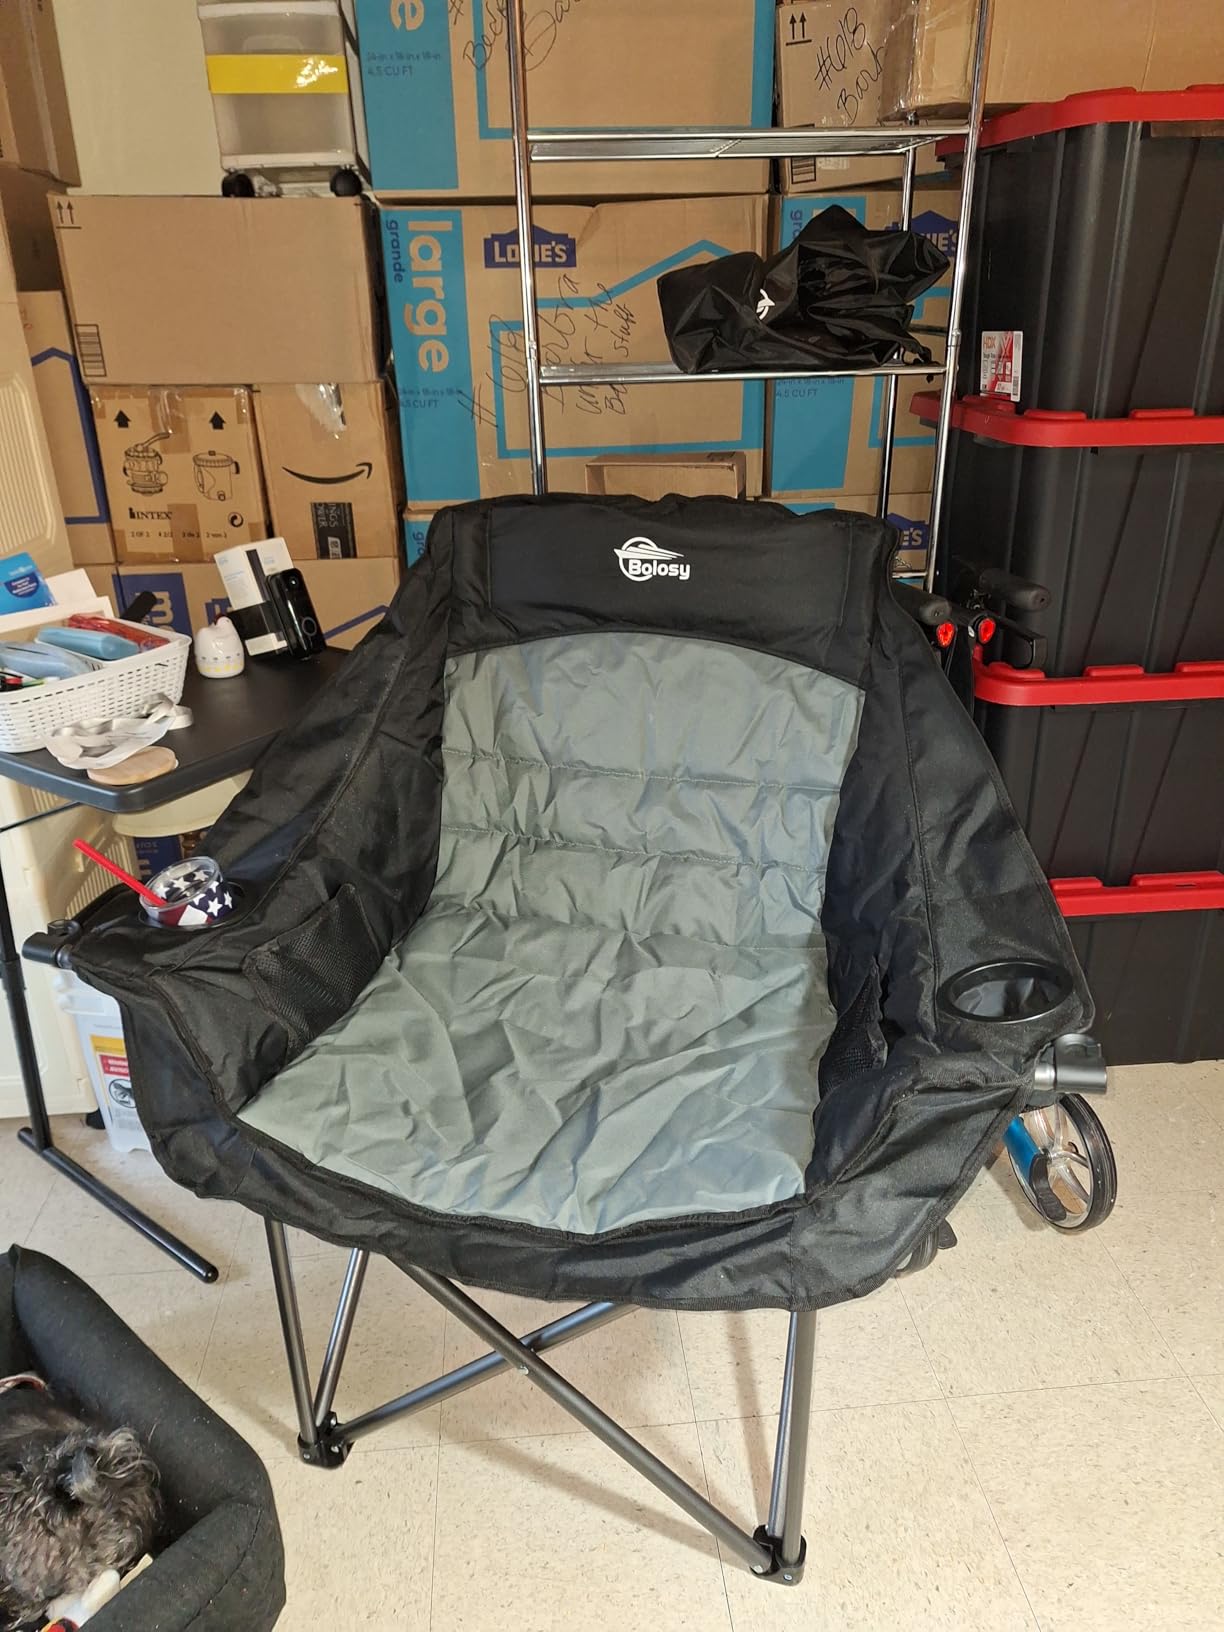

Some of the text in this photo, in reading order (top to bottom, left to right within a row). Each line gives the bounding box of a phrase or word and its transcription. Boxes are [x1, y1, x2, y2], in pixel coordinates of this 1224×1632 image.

[386, 220, 406, 283] grande
[404, 220, 453, 373] large
[136, 511, 173, 520] INTEX
[328, 503, 337, 528] INGS
[628, 560, 691, 580] Bolosy
